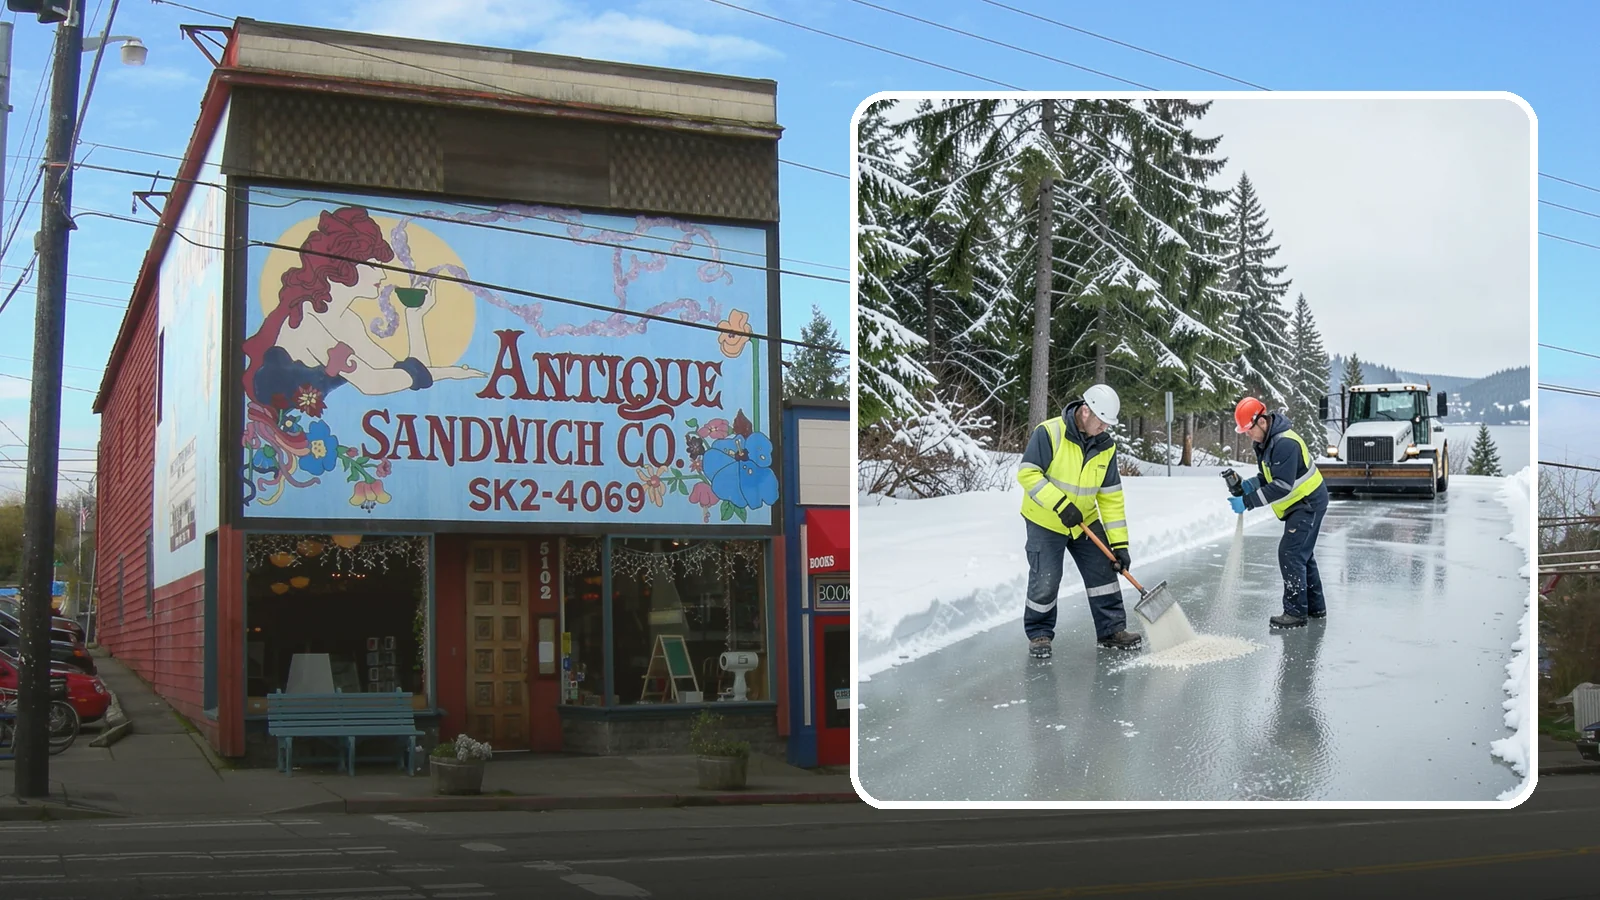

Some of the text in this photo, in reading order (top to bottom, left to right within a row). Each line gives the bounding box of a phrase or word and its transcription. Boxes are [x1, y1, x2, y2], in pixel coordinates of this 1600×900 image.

[475, 329, 723, 421] ANTIQUE
[361, 408, 684, 469] SANDWICH CO.
[468, 477, 645, 513] SK2-4069
[539, 542, 551, 599] 5102
[809, 555, 835, 569] BOOKS
